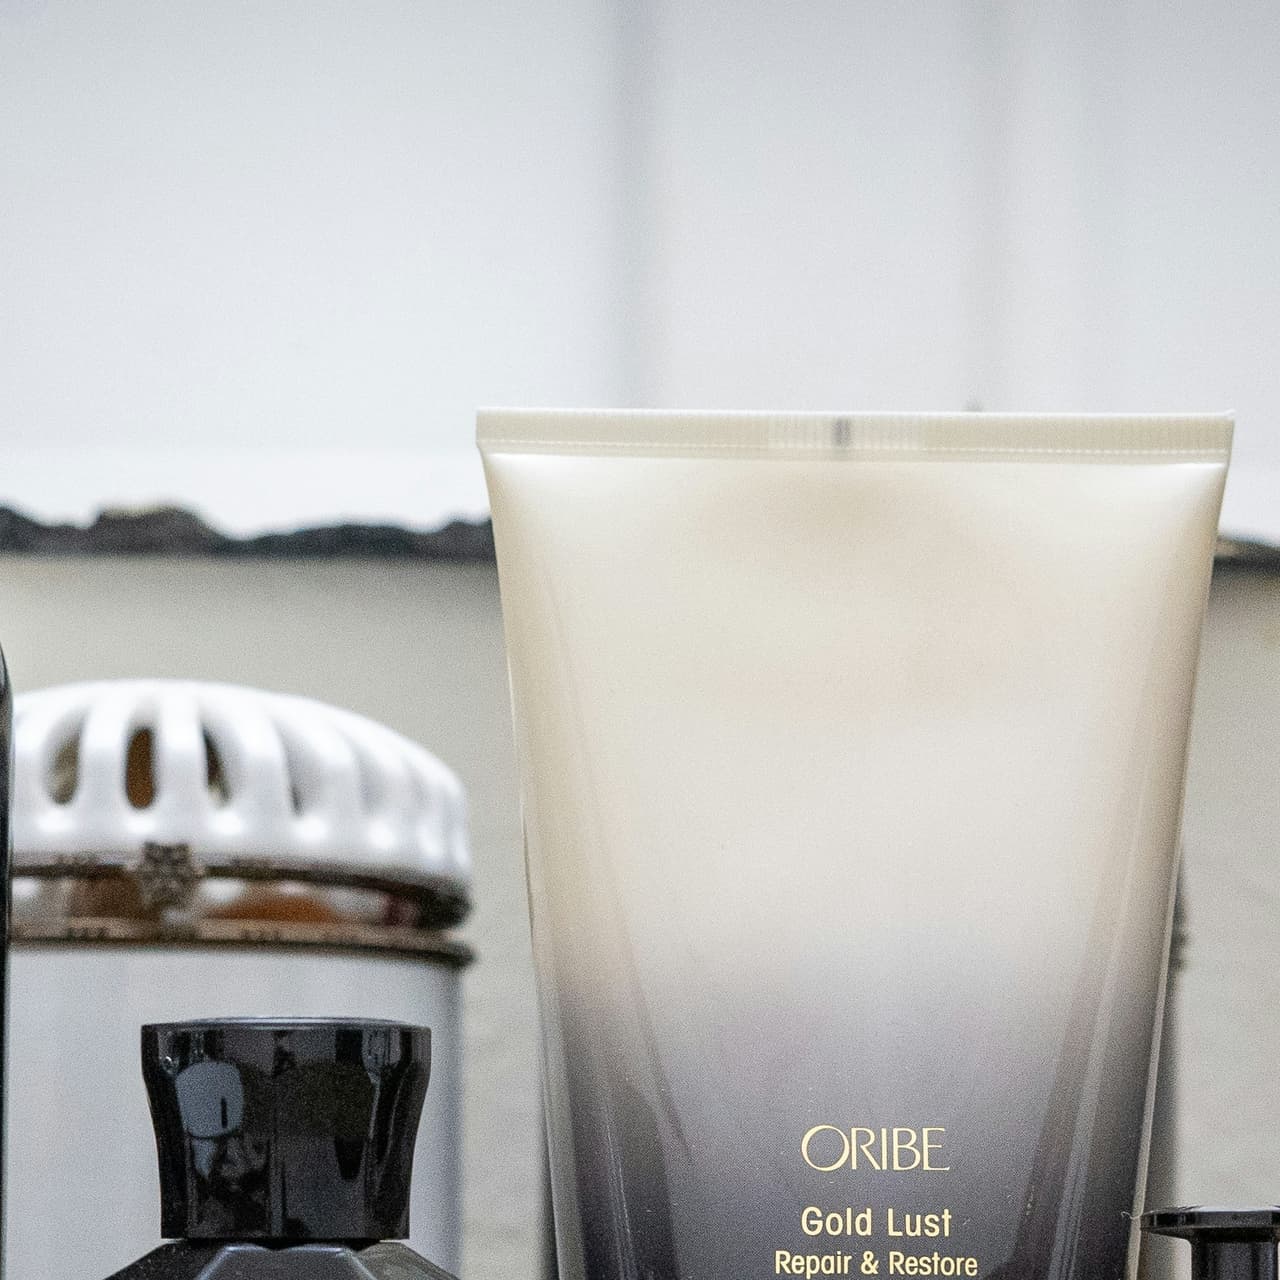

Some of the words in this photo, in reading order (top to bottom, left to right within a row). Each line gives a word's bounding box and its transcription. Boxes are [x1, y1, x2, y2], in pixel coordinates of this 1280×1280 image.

[801, 1125, 950, 1171] ORIBE
[801, 1207, 872, 1237] Gold
[888, 1207, 952, 1237] Lust
[775, 1251, 850, 1280] Repair
[861, 1251, 879, 1275] &
[889, 1252, 978, 1277] Restore
